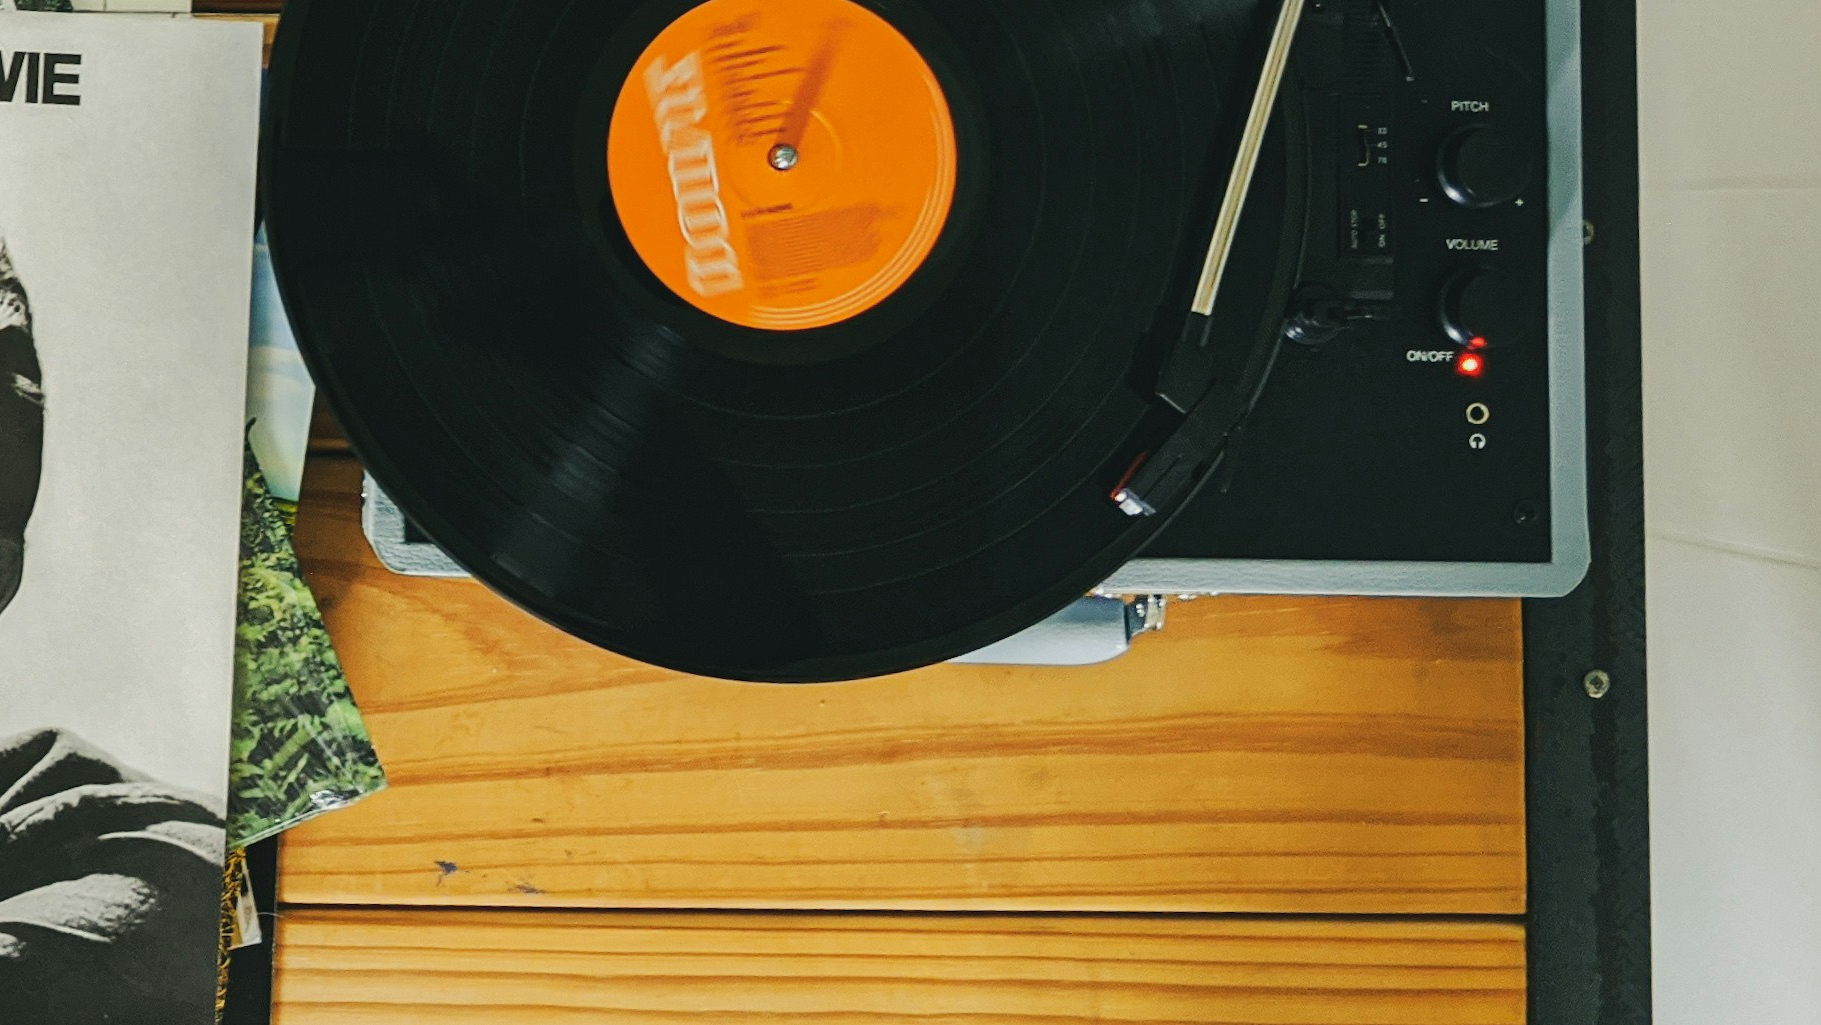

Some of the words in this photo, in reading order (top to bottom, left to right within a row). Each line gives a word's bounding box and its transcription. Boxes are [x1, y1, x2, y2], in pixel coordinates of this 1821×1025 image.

[1450, 100, 1490, 112] PITCH
[1445, 239, 1498, 250] VOLUME
[1406, 350, 1454, 362] ON/OFF
